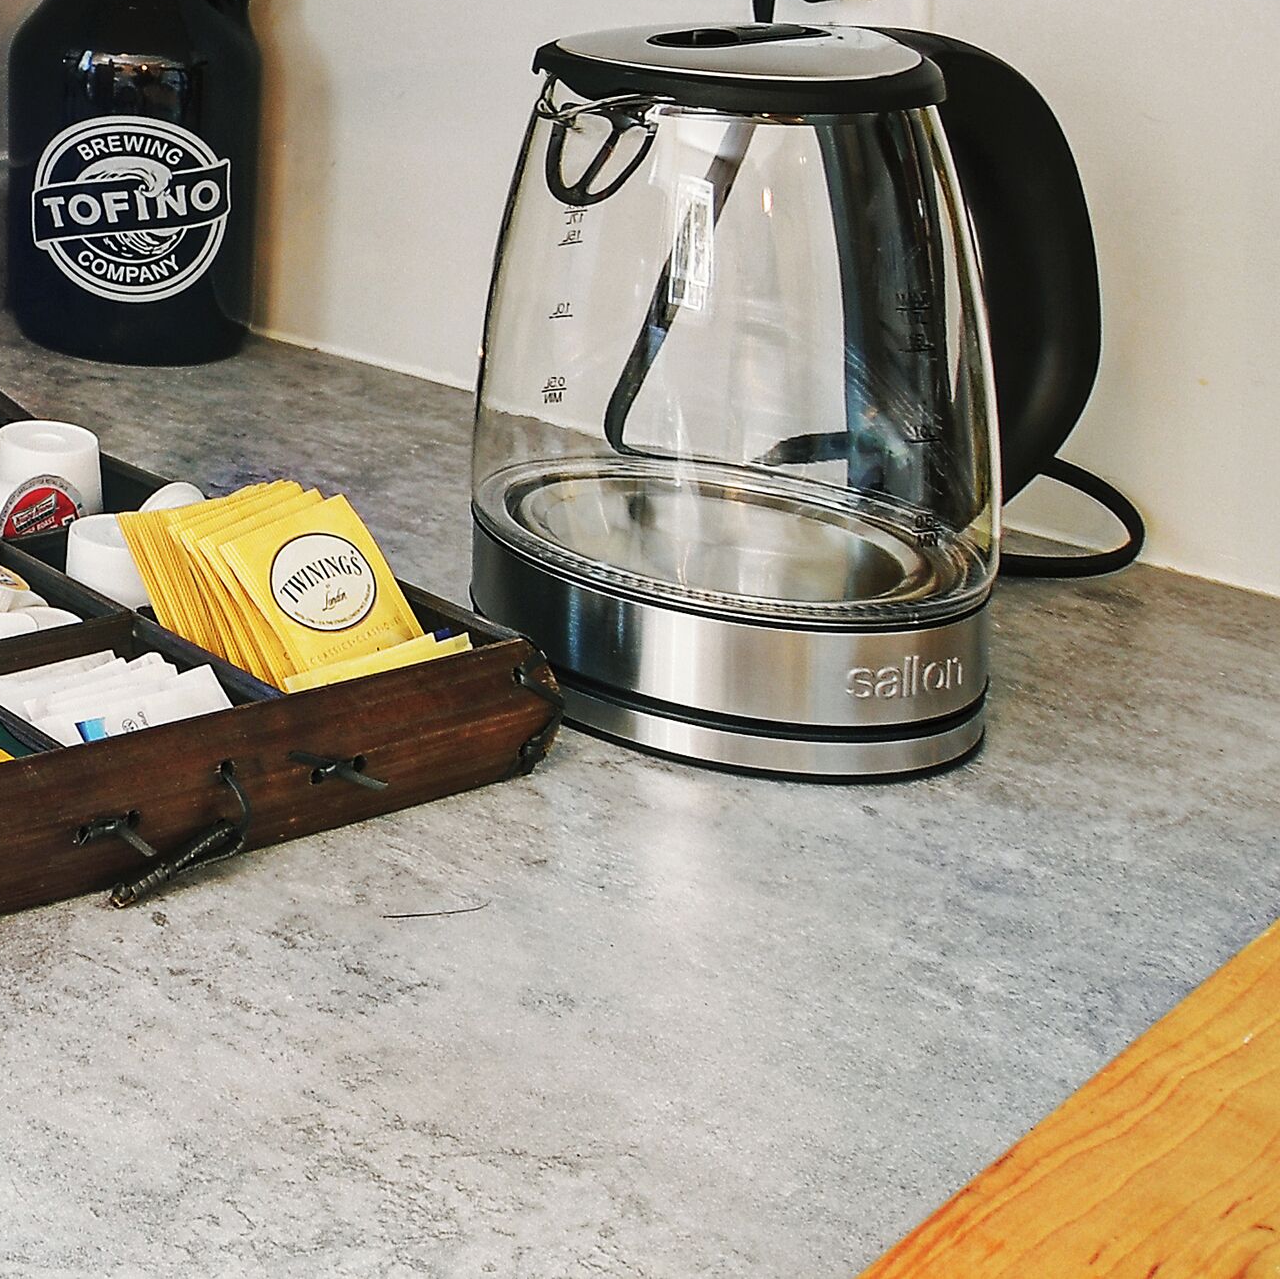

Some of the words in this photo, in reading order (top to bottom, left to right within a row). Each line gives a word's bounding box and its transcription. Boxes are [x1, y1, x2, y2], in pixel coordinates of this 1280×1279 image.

[76, 134, 184, 166] BREWING
[42, 179, 221, 228] TOFINO
[76, 249, 180, 283] COMPANY
